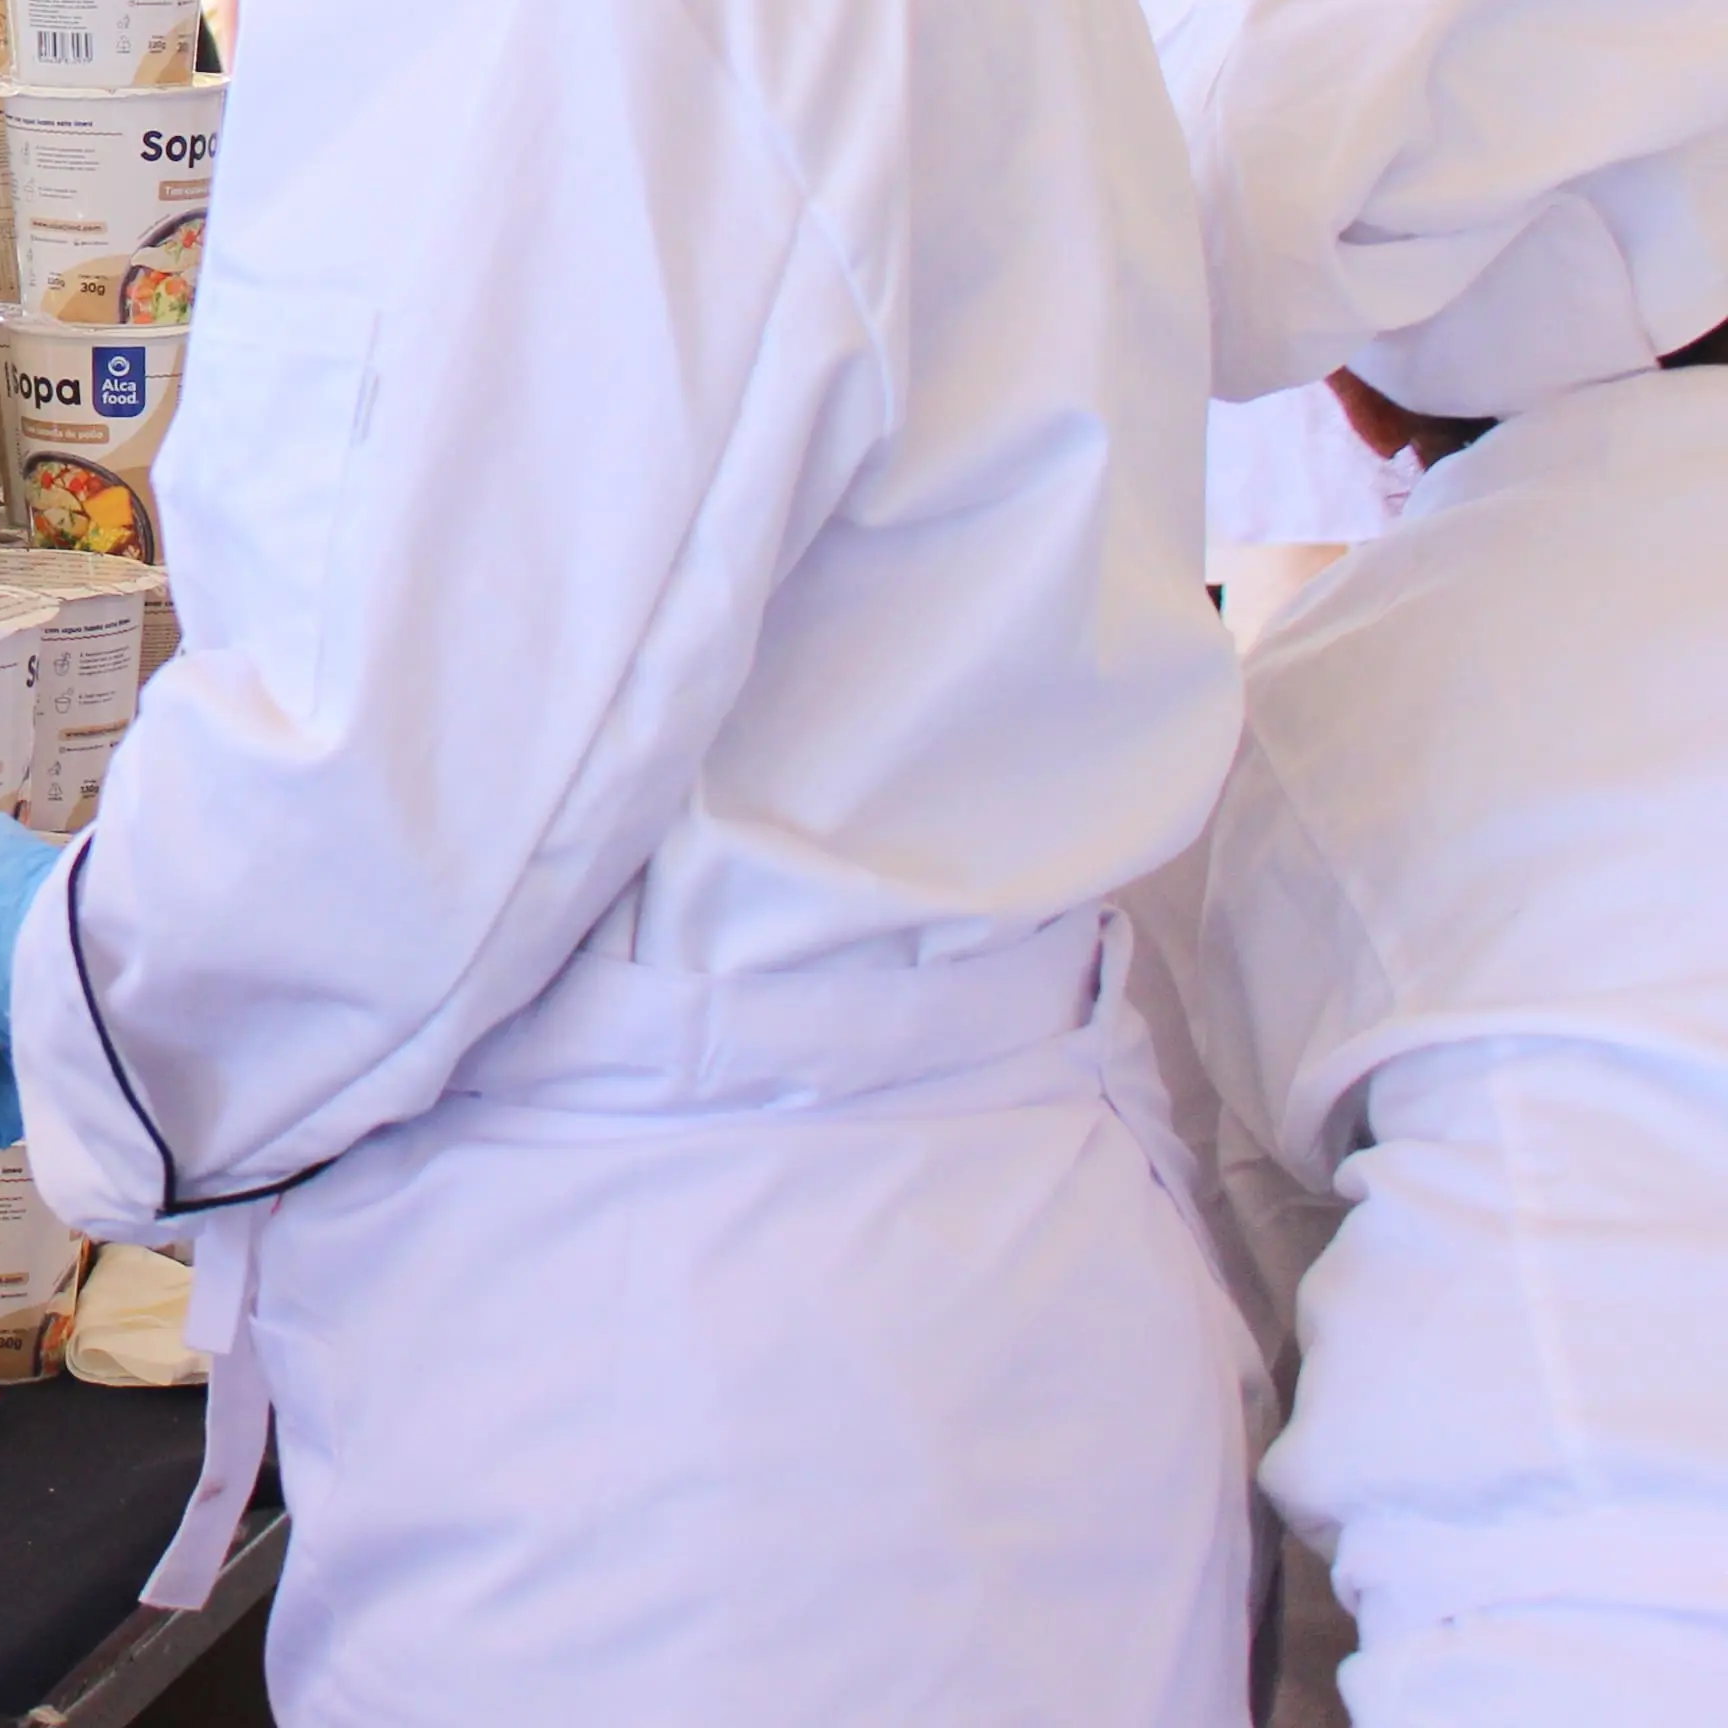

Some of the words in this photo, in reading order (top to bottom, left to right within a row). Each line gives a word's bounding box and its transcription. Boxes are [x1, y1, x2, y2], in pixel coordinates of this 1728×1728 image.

[80, 282, 105, 296] 30g
[102, 379, 136, 392] Alca
[102, 391, 136, 405] food
